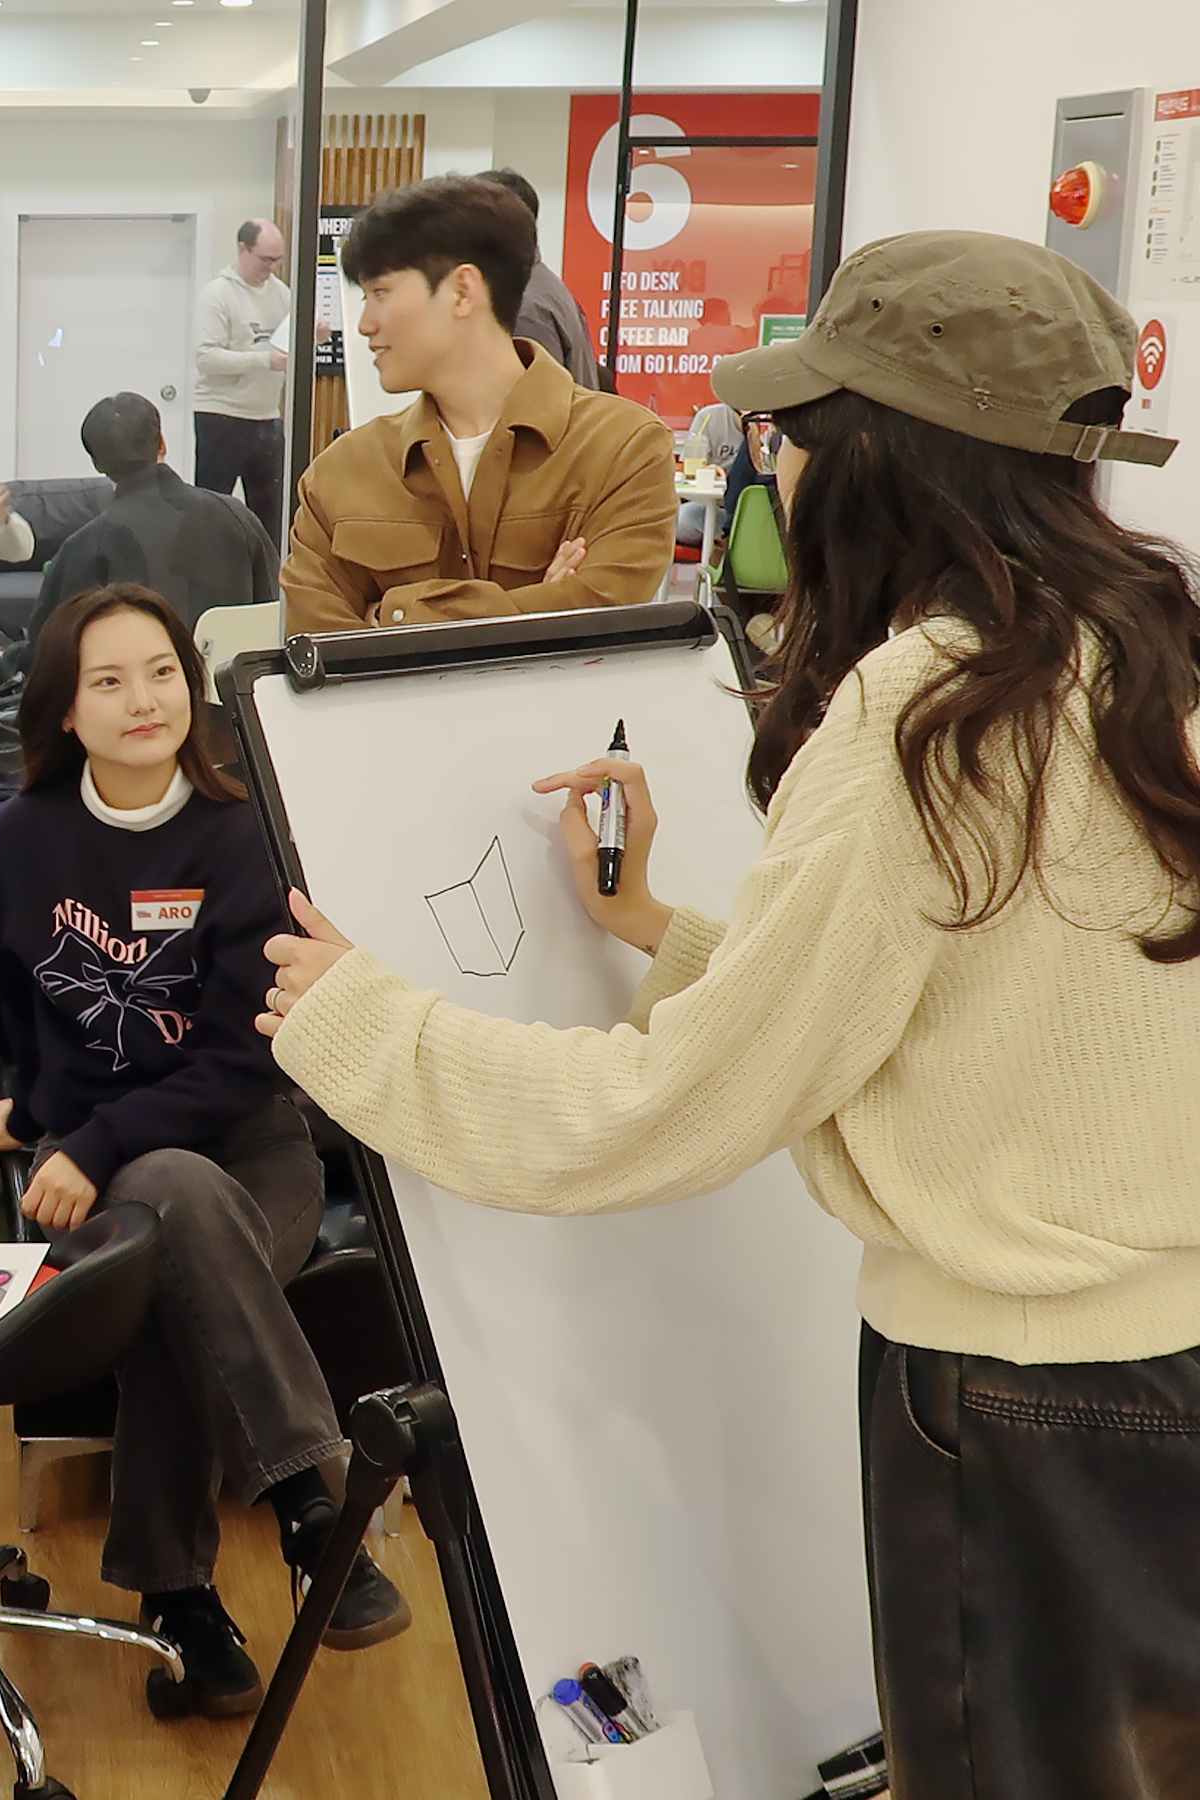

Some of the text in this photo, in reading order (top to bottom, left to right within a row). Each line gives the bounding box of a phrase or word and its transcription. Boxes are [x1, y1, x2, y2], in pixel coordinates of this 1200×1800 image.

[587, 114, 692, 251] 6
[602, 271, 680, 291] IFO DESK
[601, 299, 704, 319] FEE TALKING
[599, 326, 689, 347] CFFEE BAR
[158, 906, 192, 919] ARO
[51, 898, 149, 965] Million
